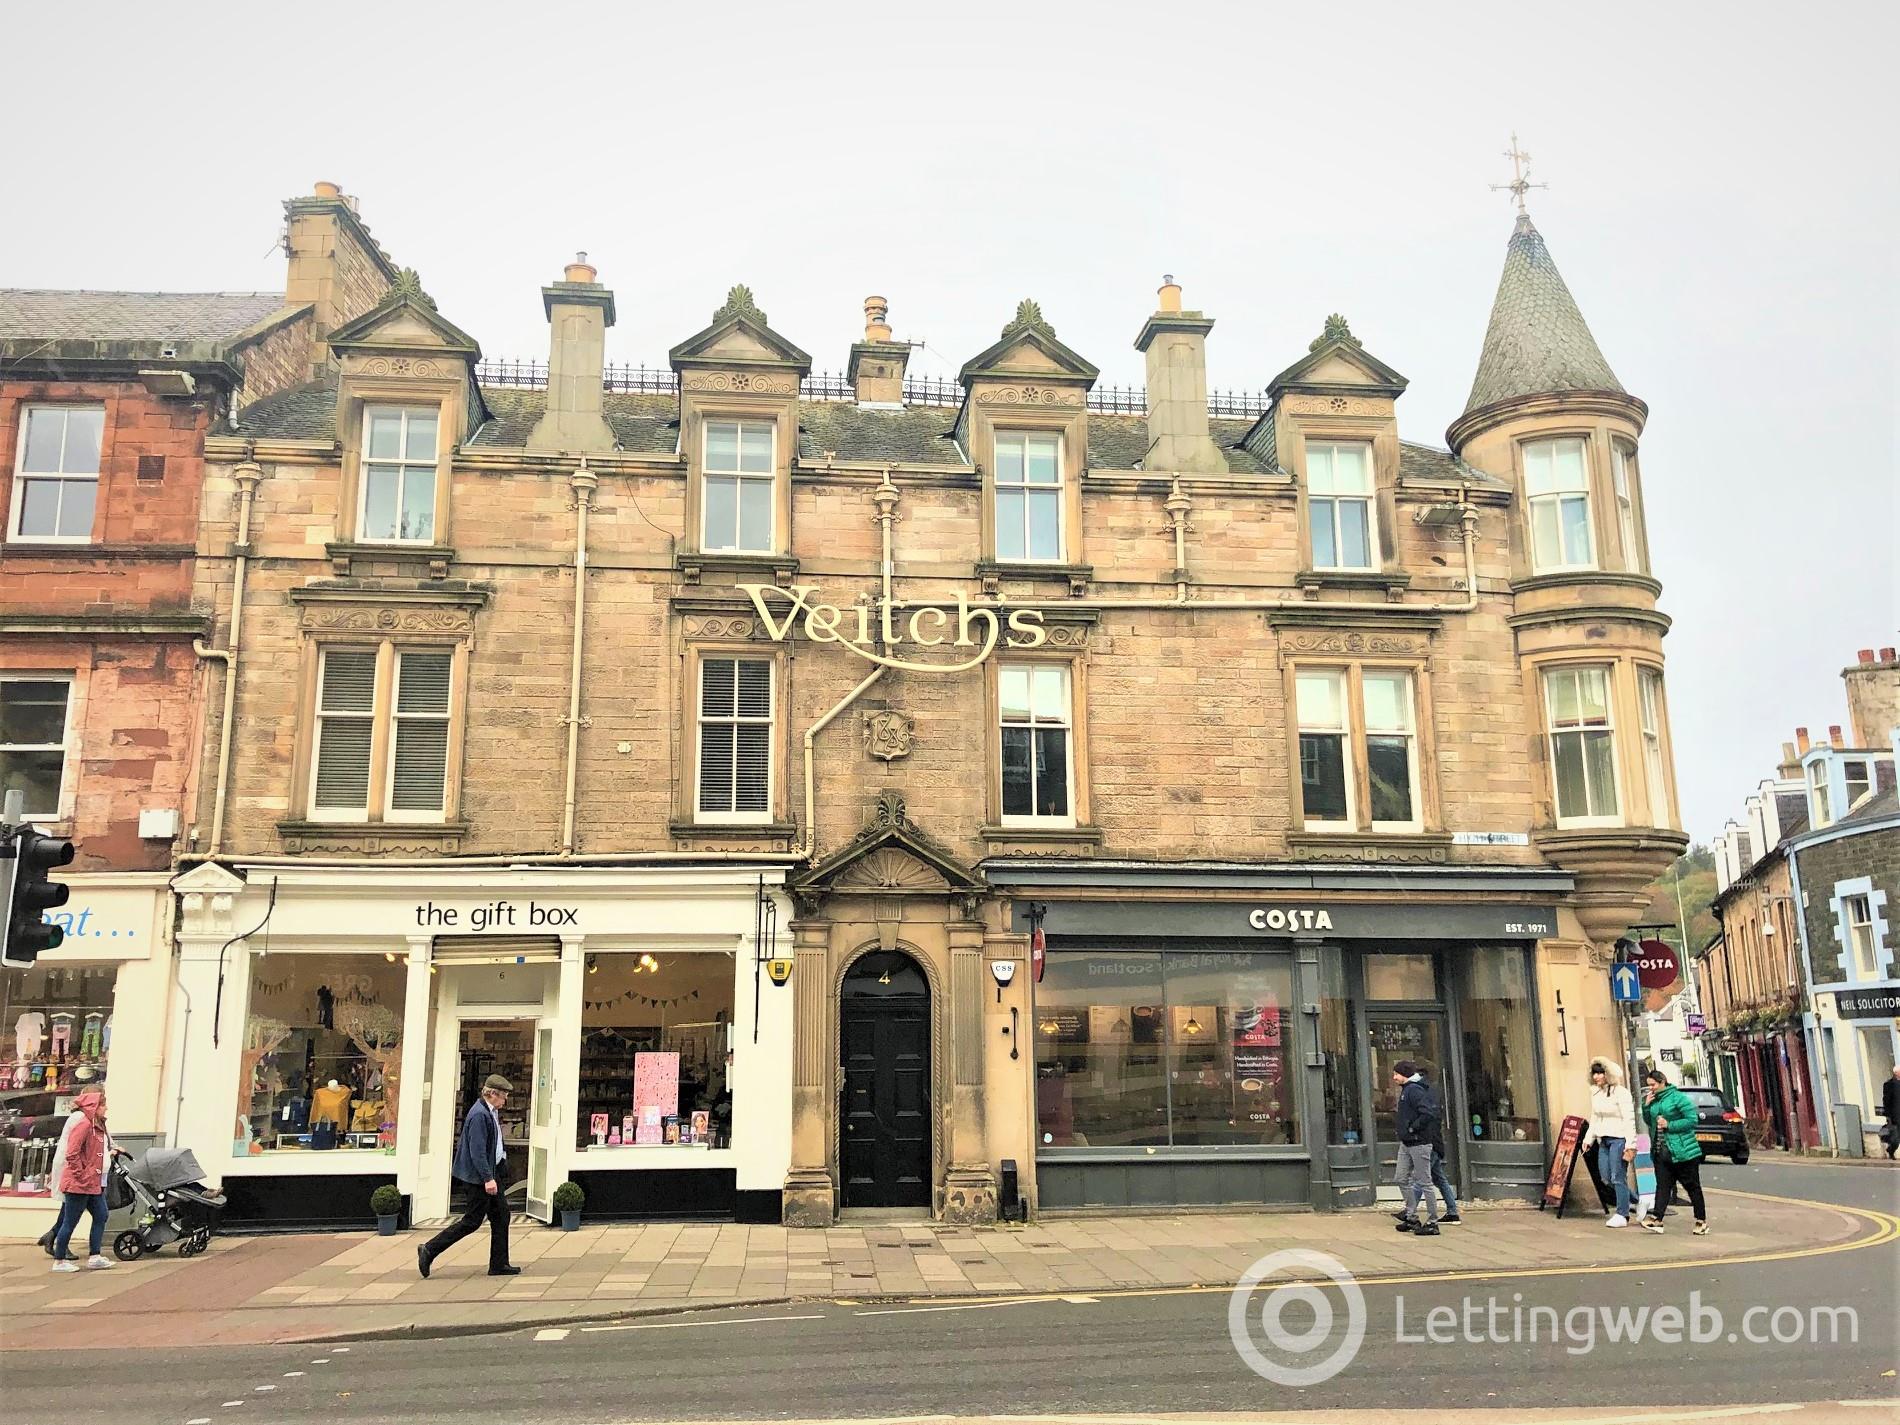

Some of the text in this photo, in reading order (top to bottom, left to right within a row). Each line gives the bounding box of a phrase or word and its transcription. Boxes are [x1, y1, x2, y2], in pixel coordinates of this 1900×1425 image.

[416, 901, 578, 931] the gift box
[1249, 909, 1333, 932] COSTA
[1505, 923, 1547, 933] EST. 1971
[878, 969, 891, 985] 4
